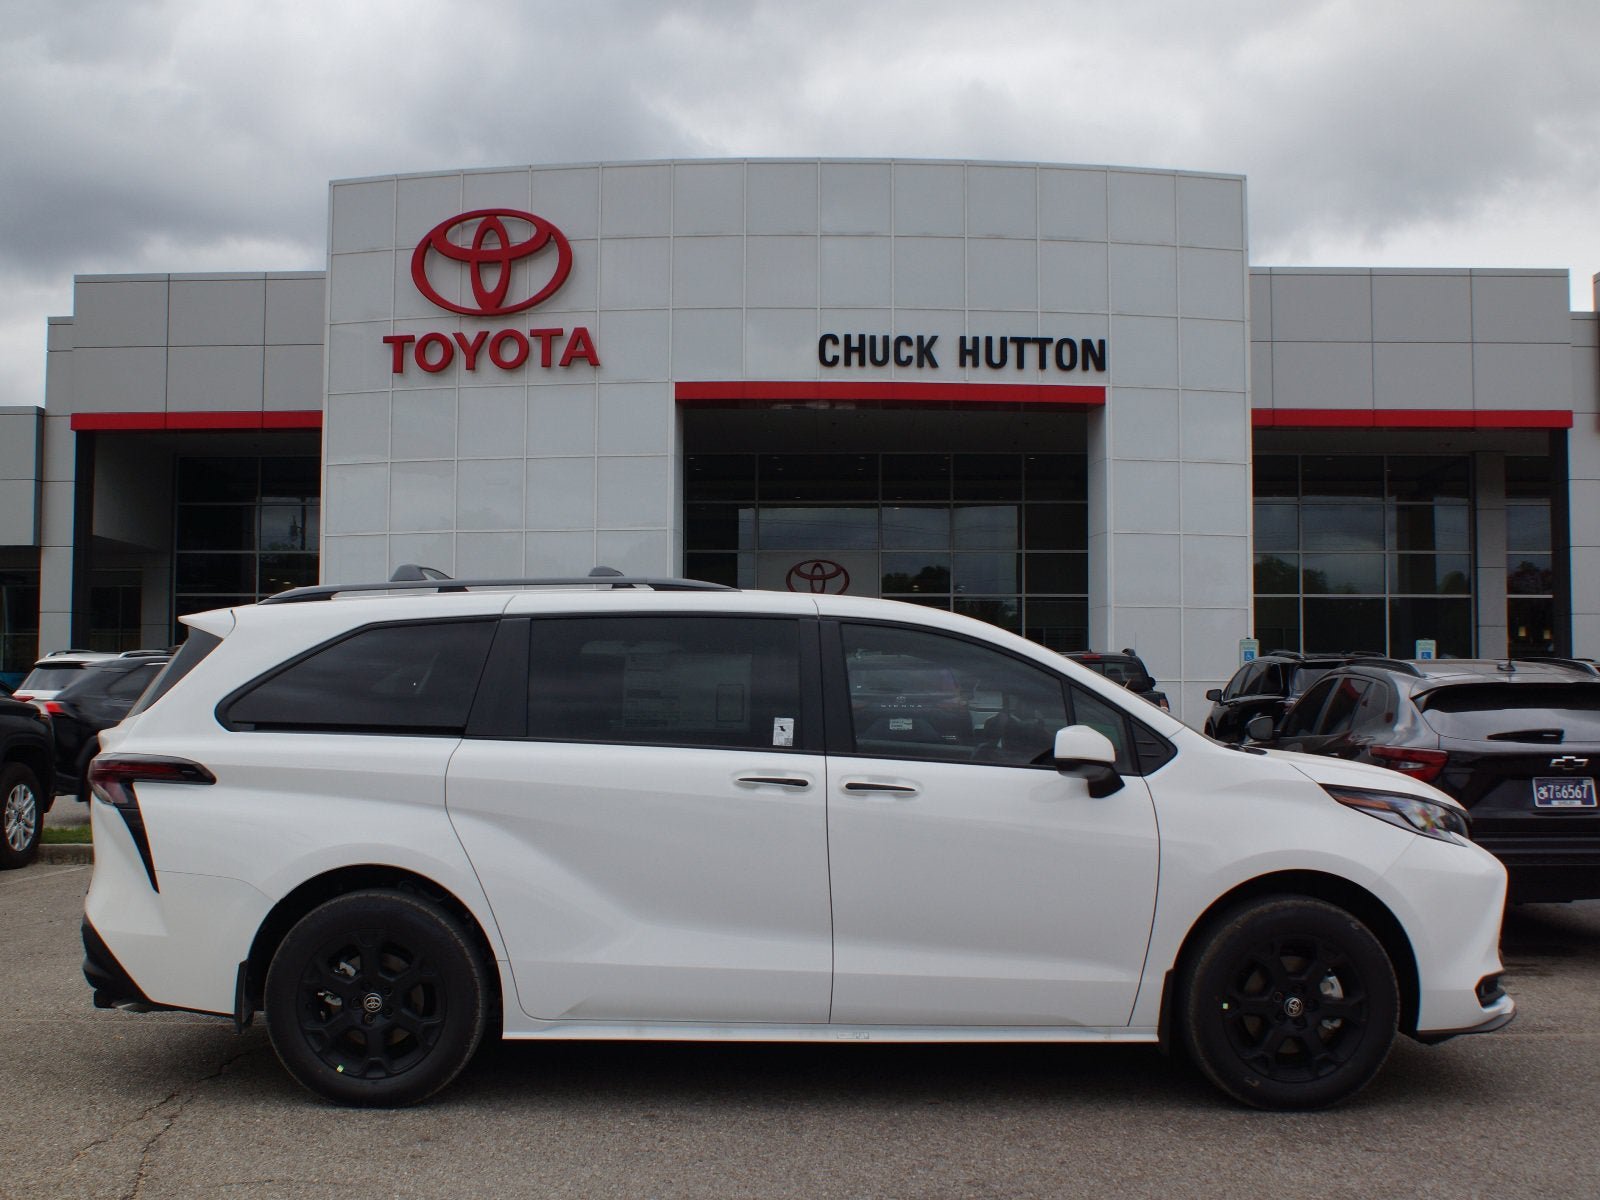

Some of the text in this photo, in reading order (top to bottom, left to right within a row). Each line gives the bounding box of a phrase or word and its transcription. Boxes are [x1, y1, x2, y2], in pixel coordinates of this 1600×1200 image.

[383, 327, 600, 373] TOYOTA
[818, 333, 1106, 371] CHUCK HUTTON
